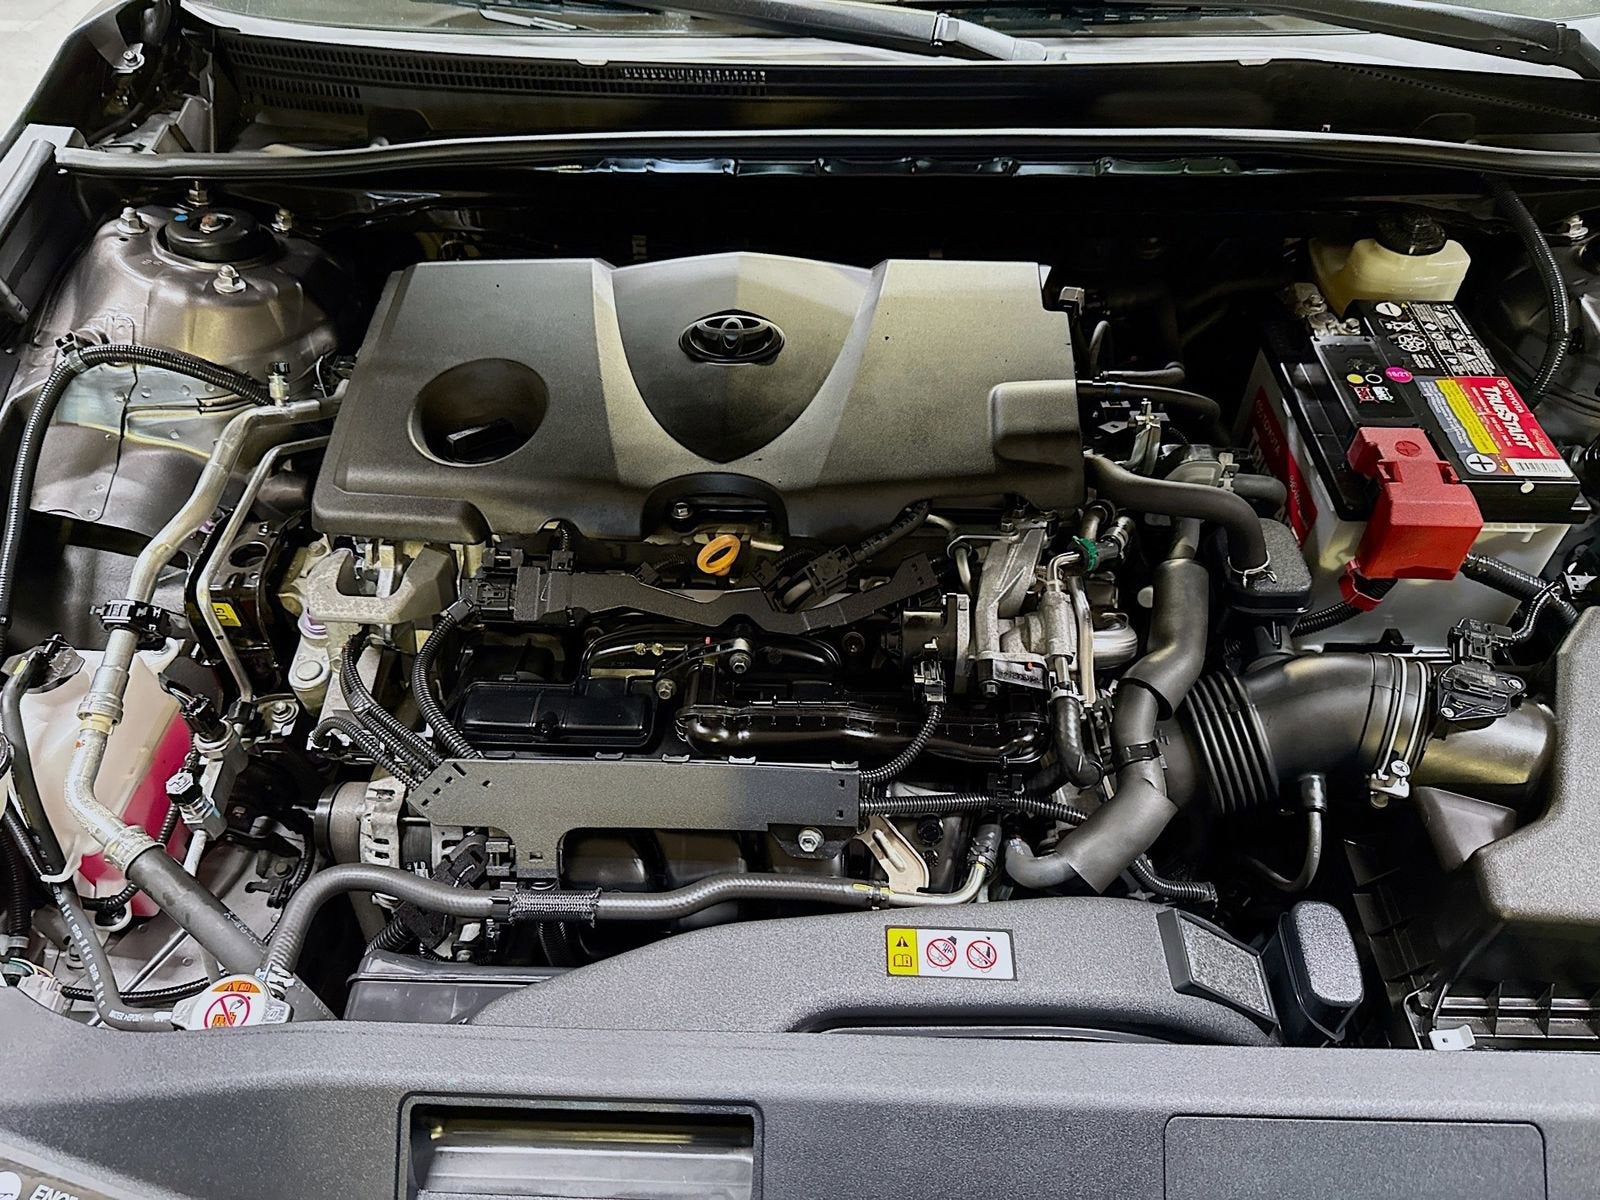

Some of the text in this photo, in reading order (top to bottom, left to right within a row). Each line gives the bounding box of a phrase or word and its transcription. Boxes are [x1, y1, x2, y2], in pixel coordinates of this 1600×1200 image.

[1503, 388, 1526, 414] TOYOTA
[1479, 385, 1535, 449] TRUESTART
[29, 1184, 79, 1200] EN
